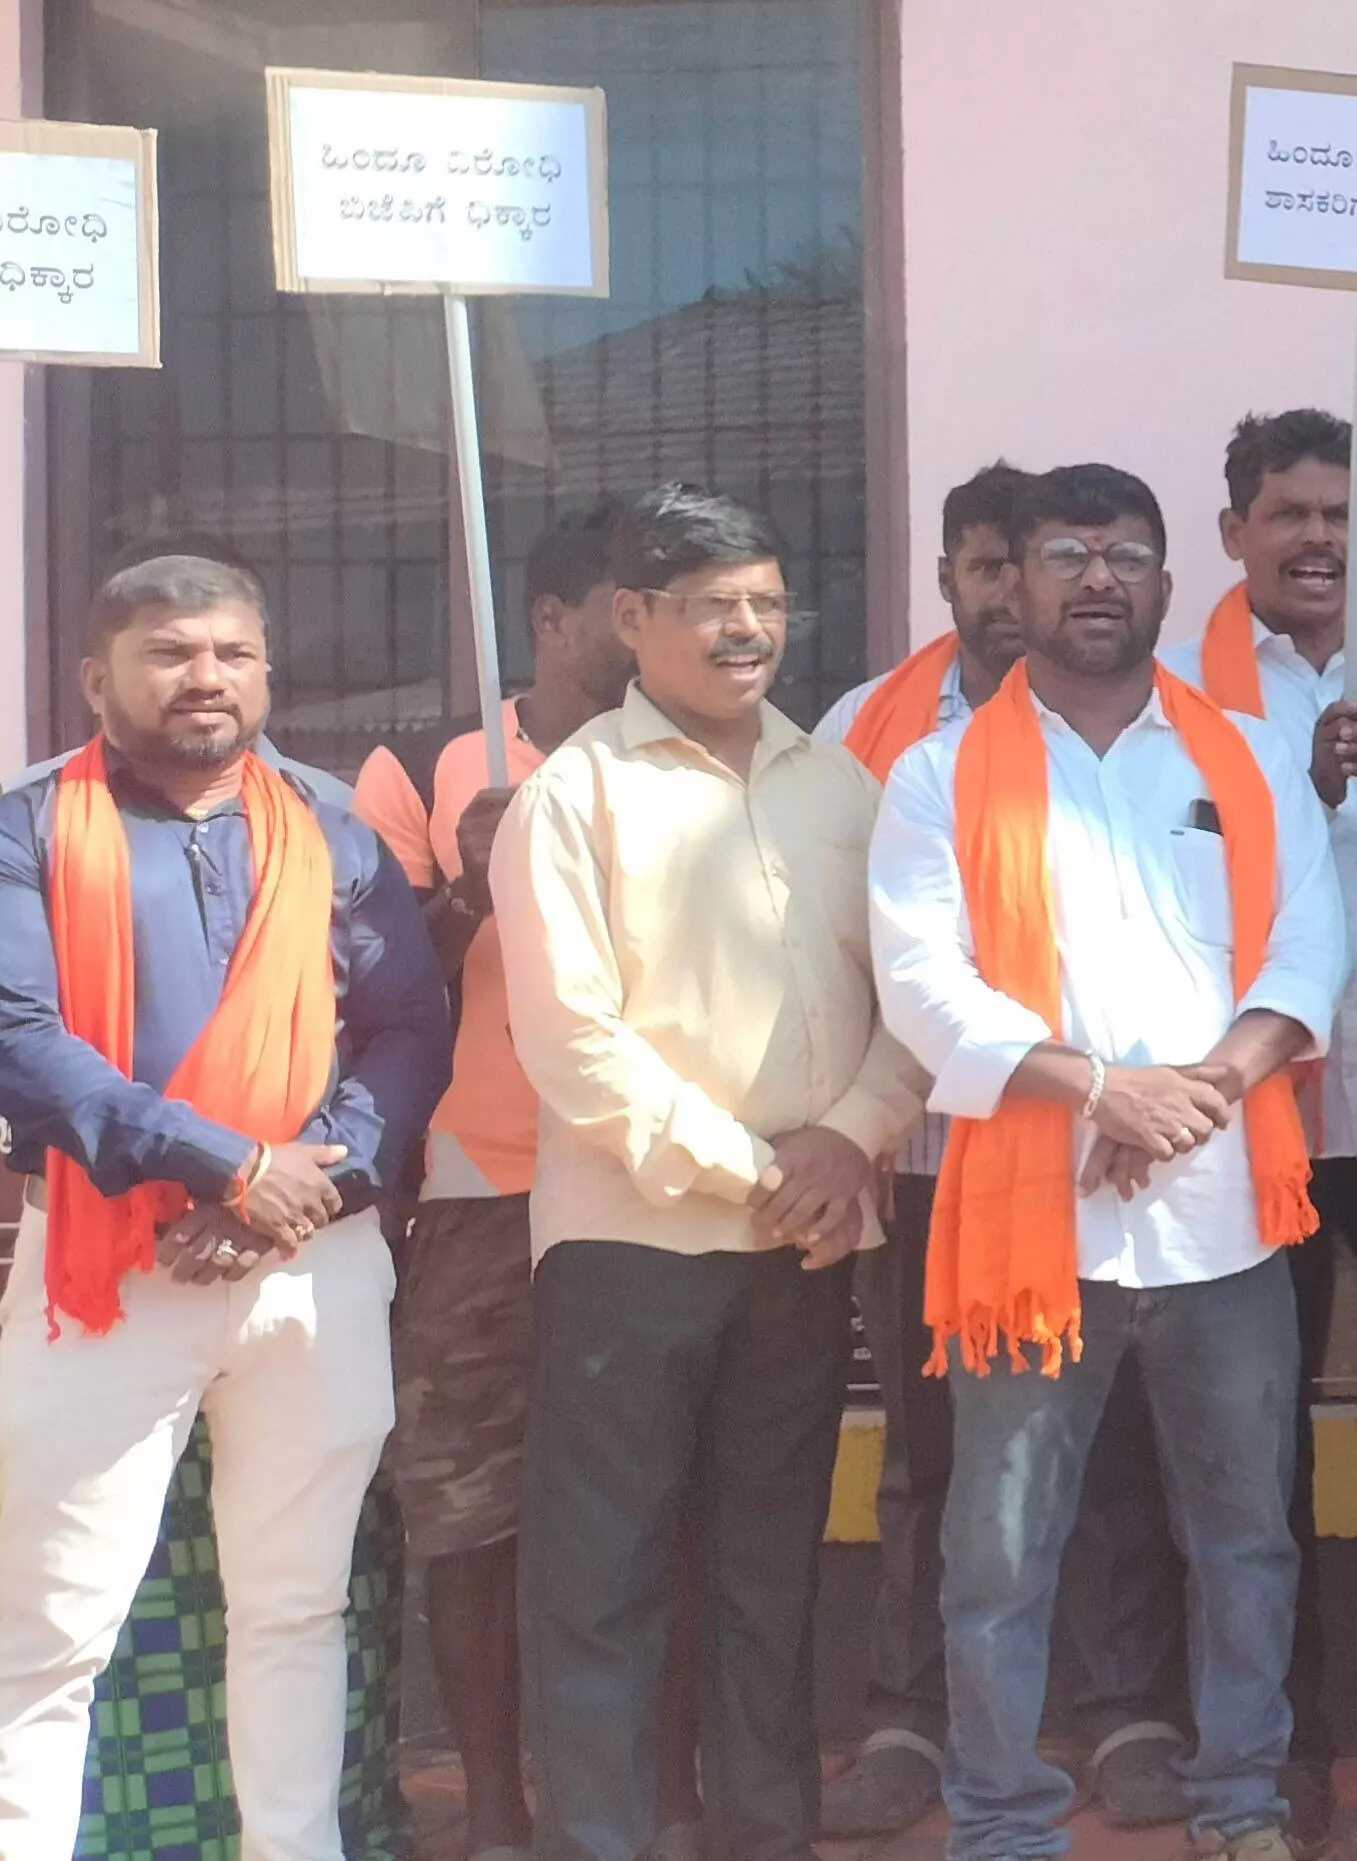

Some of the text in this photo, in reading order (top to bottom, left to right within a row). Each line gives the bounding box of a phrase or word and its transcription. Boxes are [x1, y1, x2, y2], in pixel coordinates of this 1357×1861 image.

[1266, 139, 1353, 168] ಹಿಂದೂ
[0, 206, 108, 243] ರೋಧಿ
[466, 200, 552, 242] ಧಿಕ್ಕಾರ
